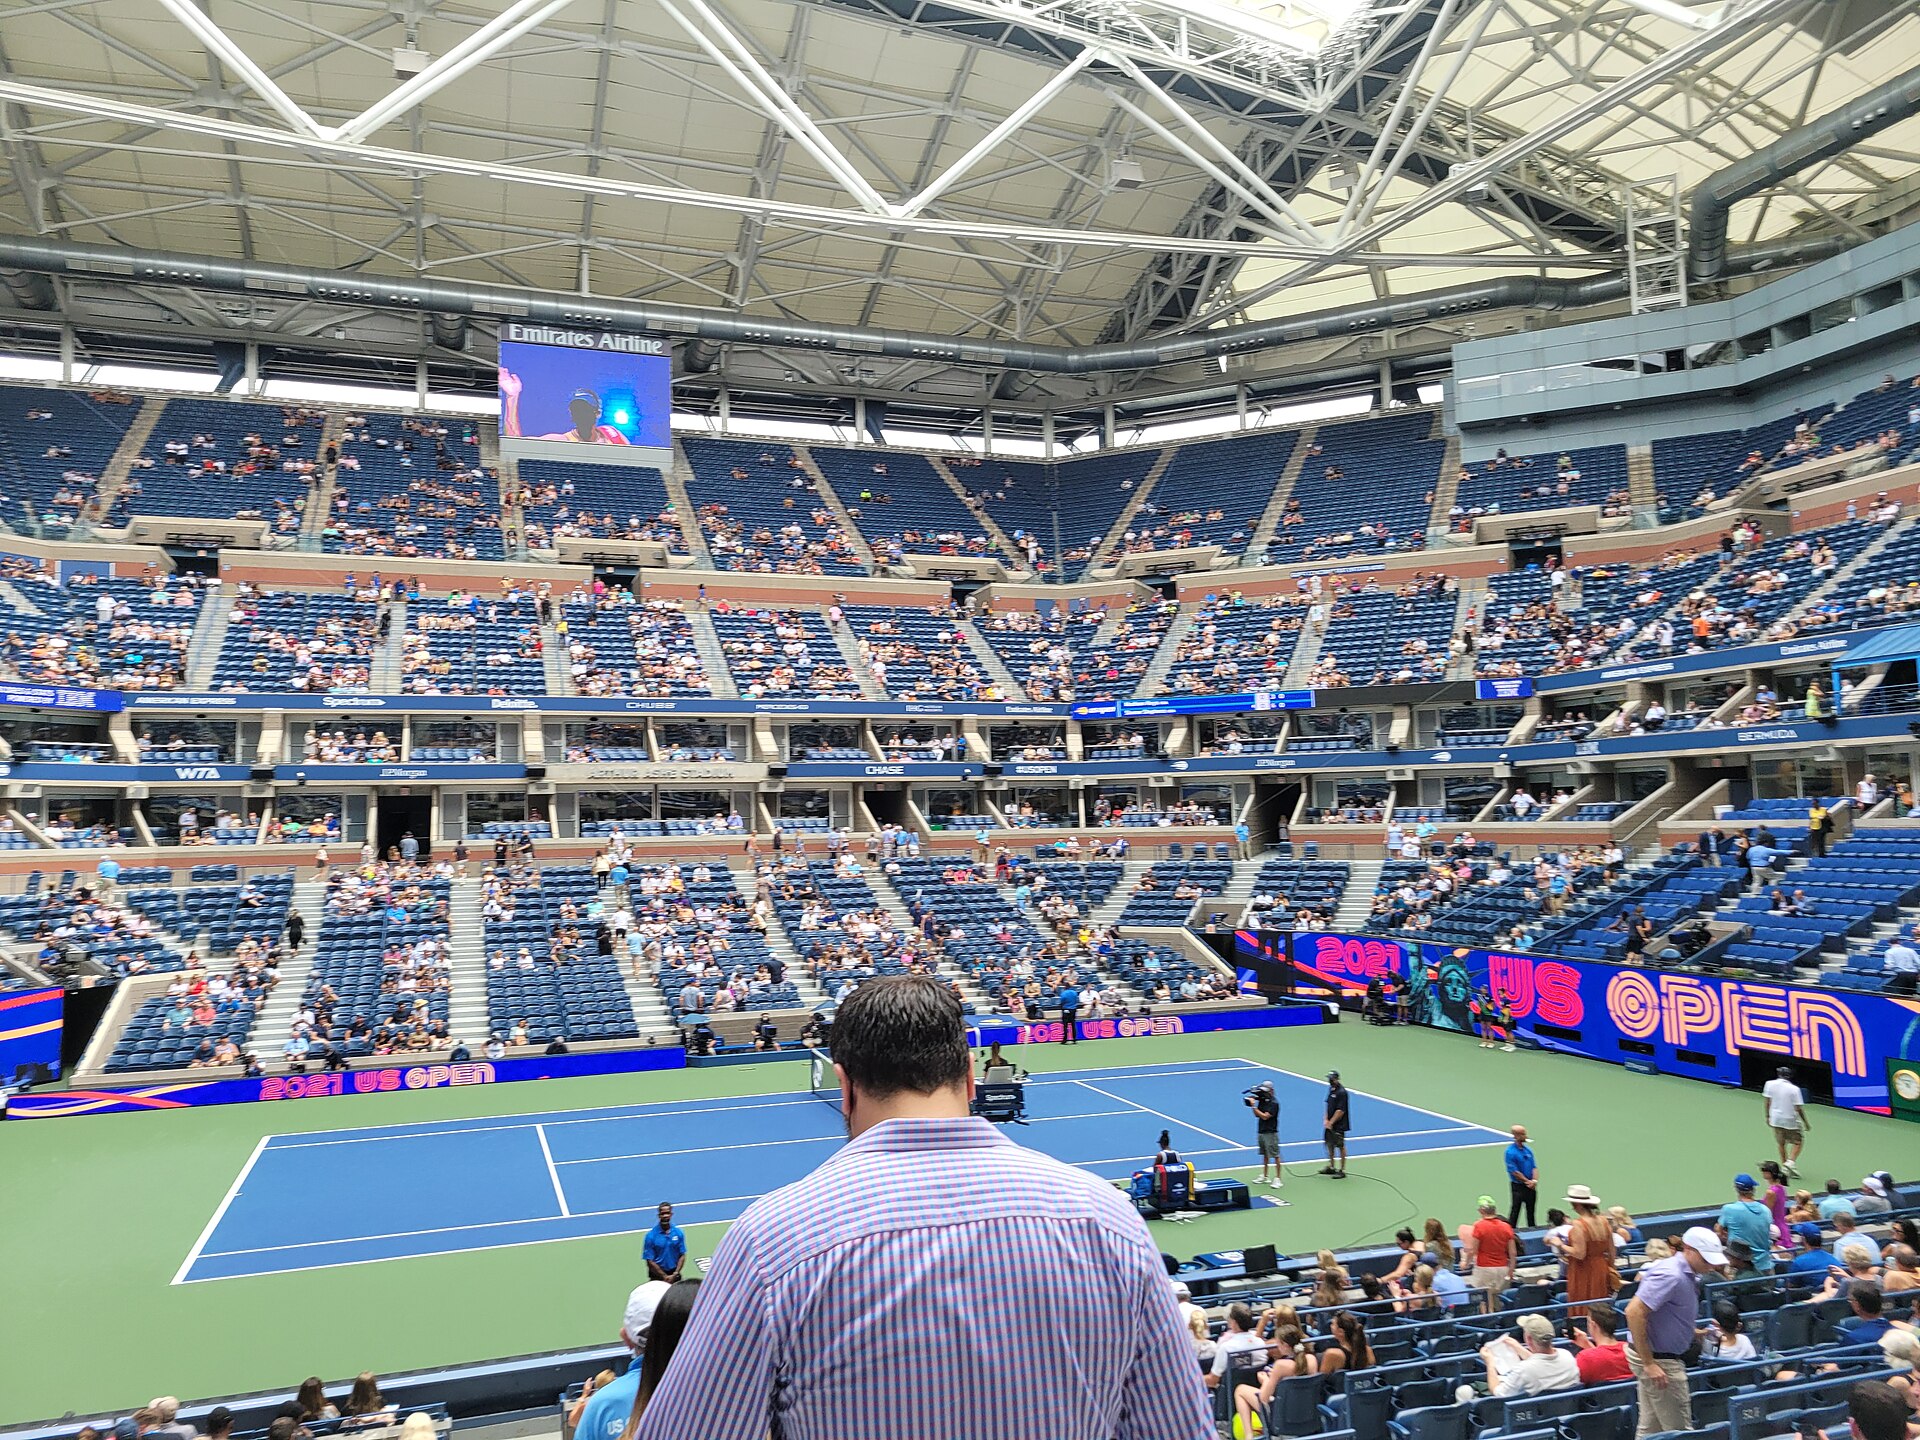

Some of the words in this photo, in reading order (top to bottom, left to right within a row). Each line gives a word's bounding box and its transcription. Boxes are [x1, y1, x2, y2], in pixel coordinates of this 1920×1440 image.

[508, 323, 594, 347] Emirates
[597, 333, 663, 354] Airline
[1737, 729, 1799, 742] BERMUDA
[175, 767, 221, 779] WTA
[587, 768, 639, 779] ARTHUR
[643, 768, 677, 779] ASHE
[681, 768, 735, 779] STADIUM
[865, 766, 905, 775] CHASE
[1315, 936, 1400, 978] 2021
[1487, 955, 1585, 1027] US
[1606, 970, 1867, 1078] OPEN
[1082, 1019, 1115, 1039] US
[259, 1073, 343, 1101] 2021
[354, 1069, 401, 1093] US
[607, 1418, 624, 1435] US
